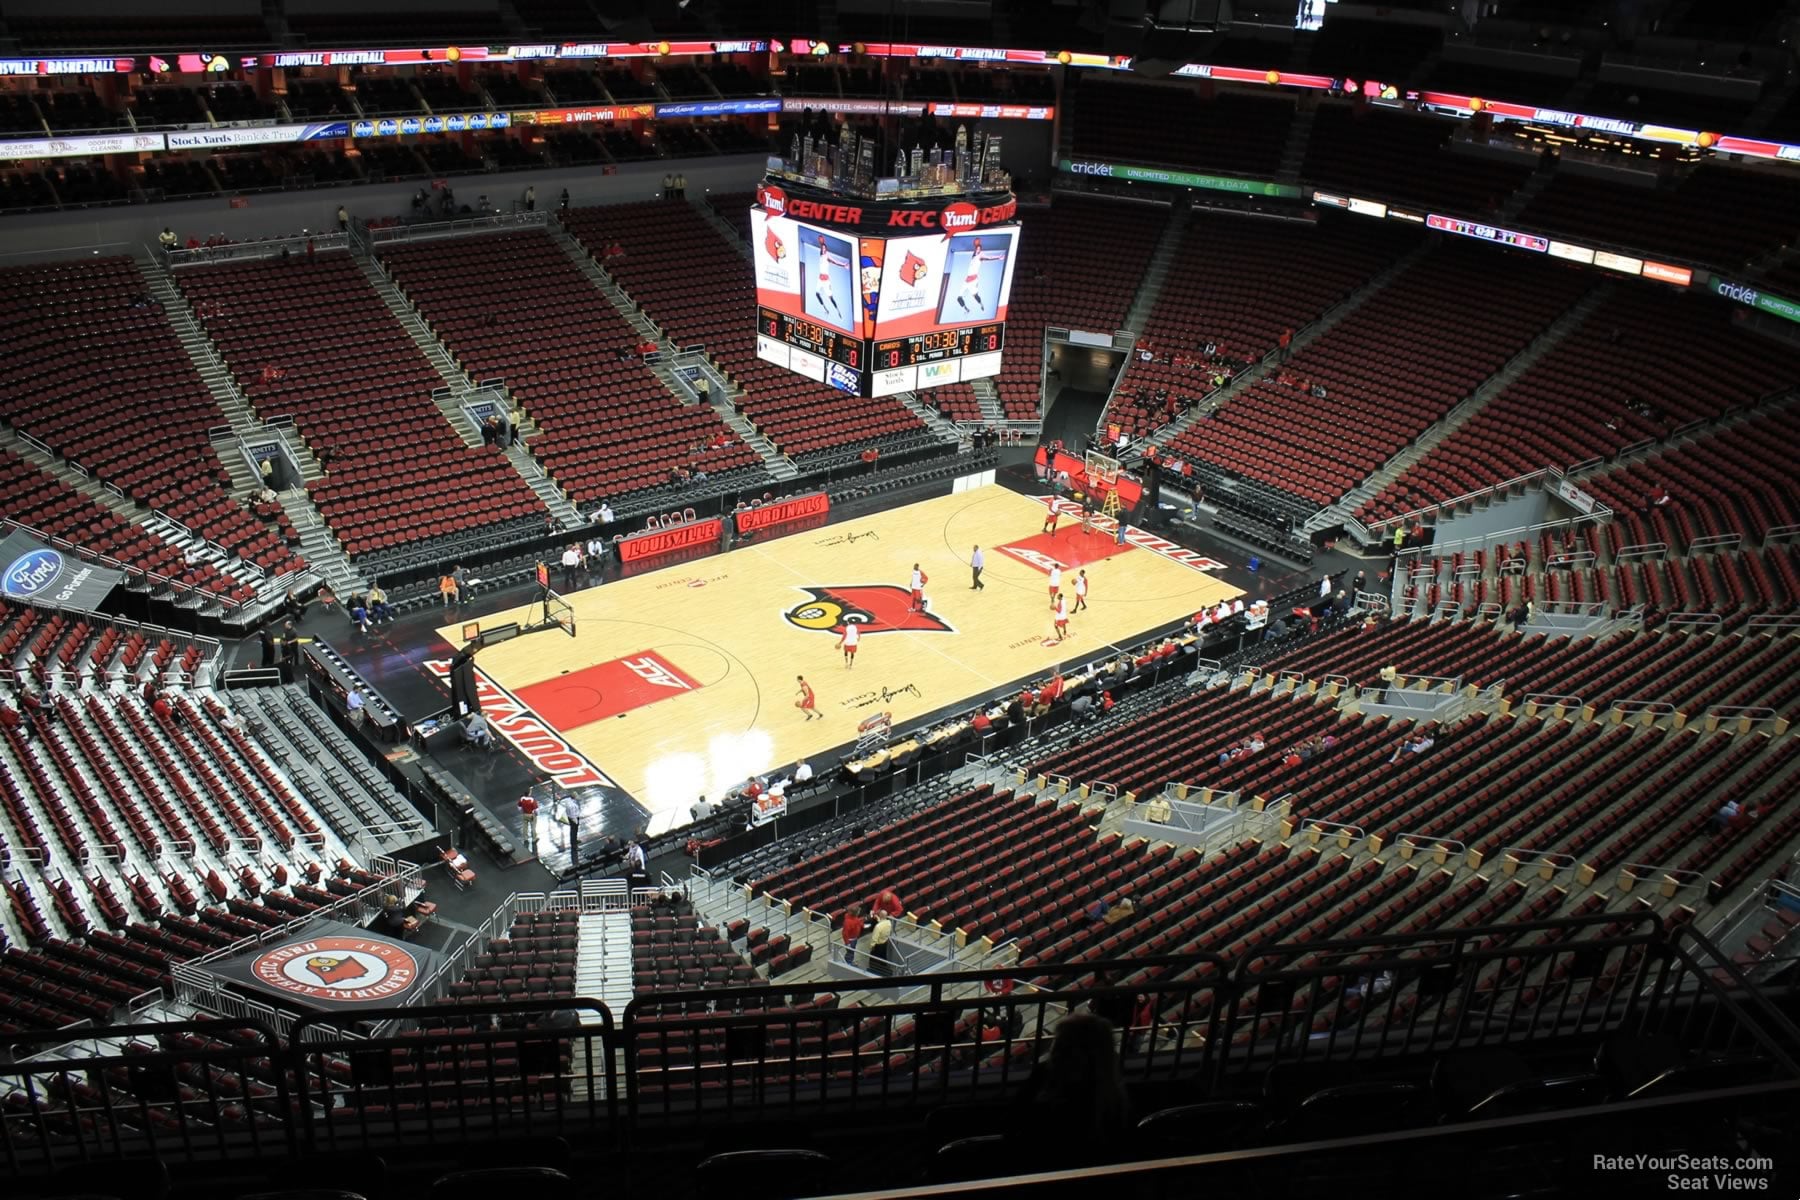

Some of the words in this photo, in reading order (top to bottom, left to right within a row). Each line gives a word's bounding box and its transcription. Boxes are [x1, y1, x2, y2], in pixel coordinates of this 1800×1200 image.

[48, 60, 115, 73] BASKETBALL
[275, 54, 323, 66] LOUISVILLE
[330, 51, 384, 64] BASKETBALL
[566, 112, 572, 122] a
[574, 109, 614, 121] win-win
[828, 103, 852, 111] HOTEL
[171, 136, 201, 146] Stock
[202, 134, 232, 144] Yards
[234, 132, 259, 142] Bank
[261, 132, 269, 140] &
[271, 130, 299, 140] Trust
[1071, 162, 1114, 177] cricket
[1127, 169, 1169, 181] UNLIMITED
[1227, 181, 1249, 190] DATA
[764, 191, 785, 212] Yum!
[788, 199, 863, 225] CENTER
[887, 210, 937, 228] KFC
[944, 209, 978, 227] Yum!
[1718, 282, 1758, 306] cricket
[1761, 298, 1794, 314] UNLIMITED
[880, 341, 901, 351] CARDS
[925, 331, 957, 350] 47:30
[833, 363, 858, 384] BUD
[925, 364, 953, 377] WM
[741, 496, 823, 529] CARDINALS
[628, 522, 716, 557] LOUISVILLE
[12, 557, 57, 590] Ford
[56, 588, 69, 601] Go
[66, 567, 93, 591] Further
[621, 656, 693, 690] ACC
[271, 942, 318, 961] FUND
[355, 942, 392, 957] CAF
[260, 961, 320, 994] ATHLETIC
[327, 968, 411, 999] CARDINAL
